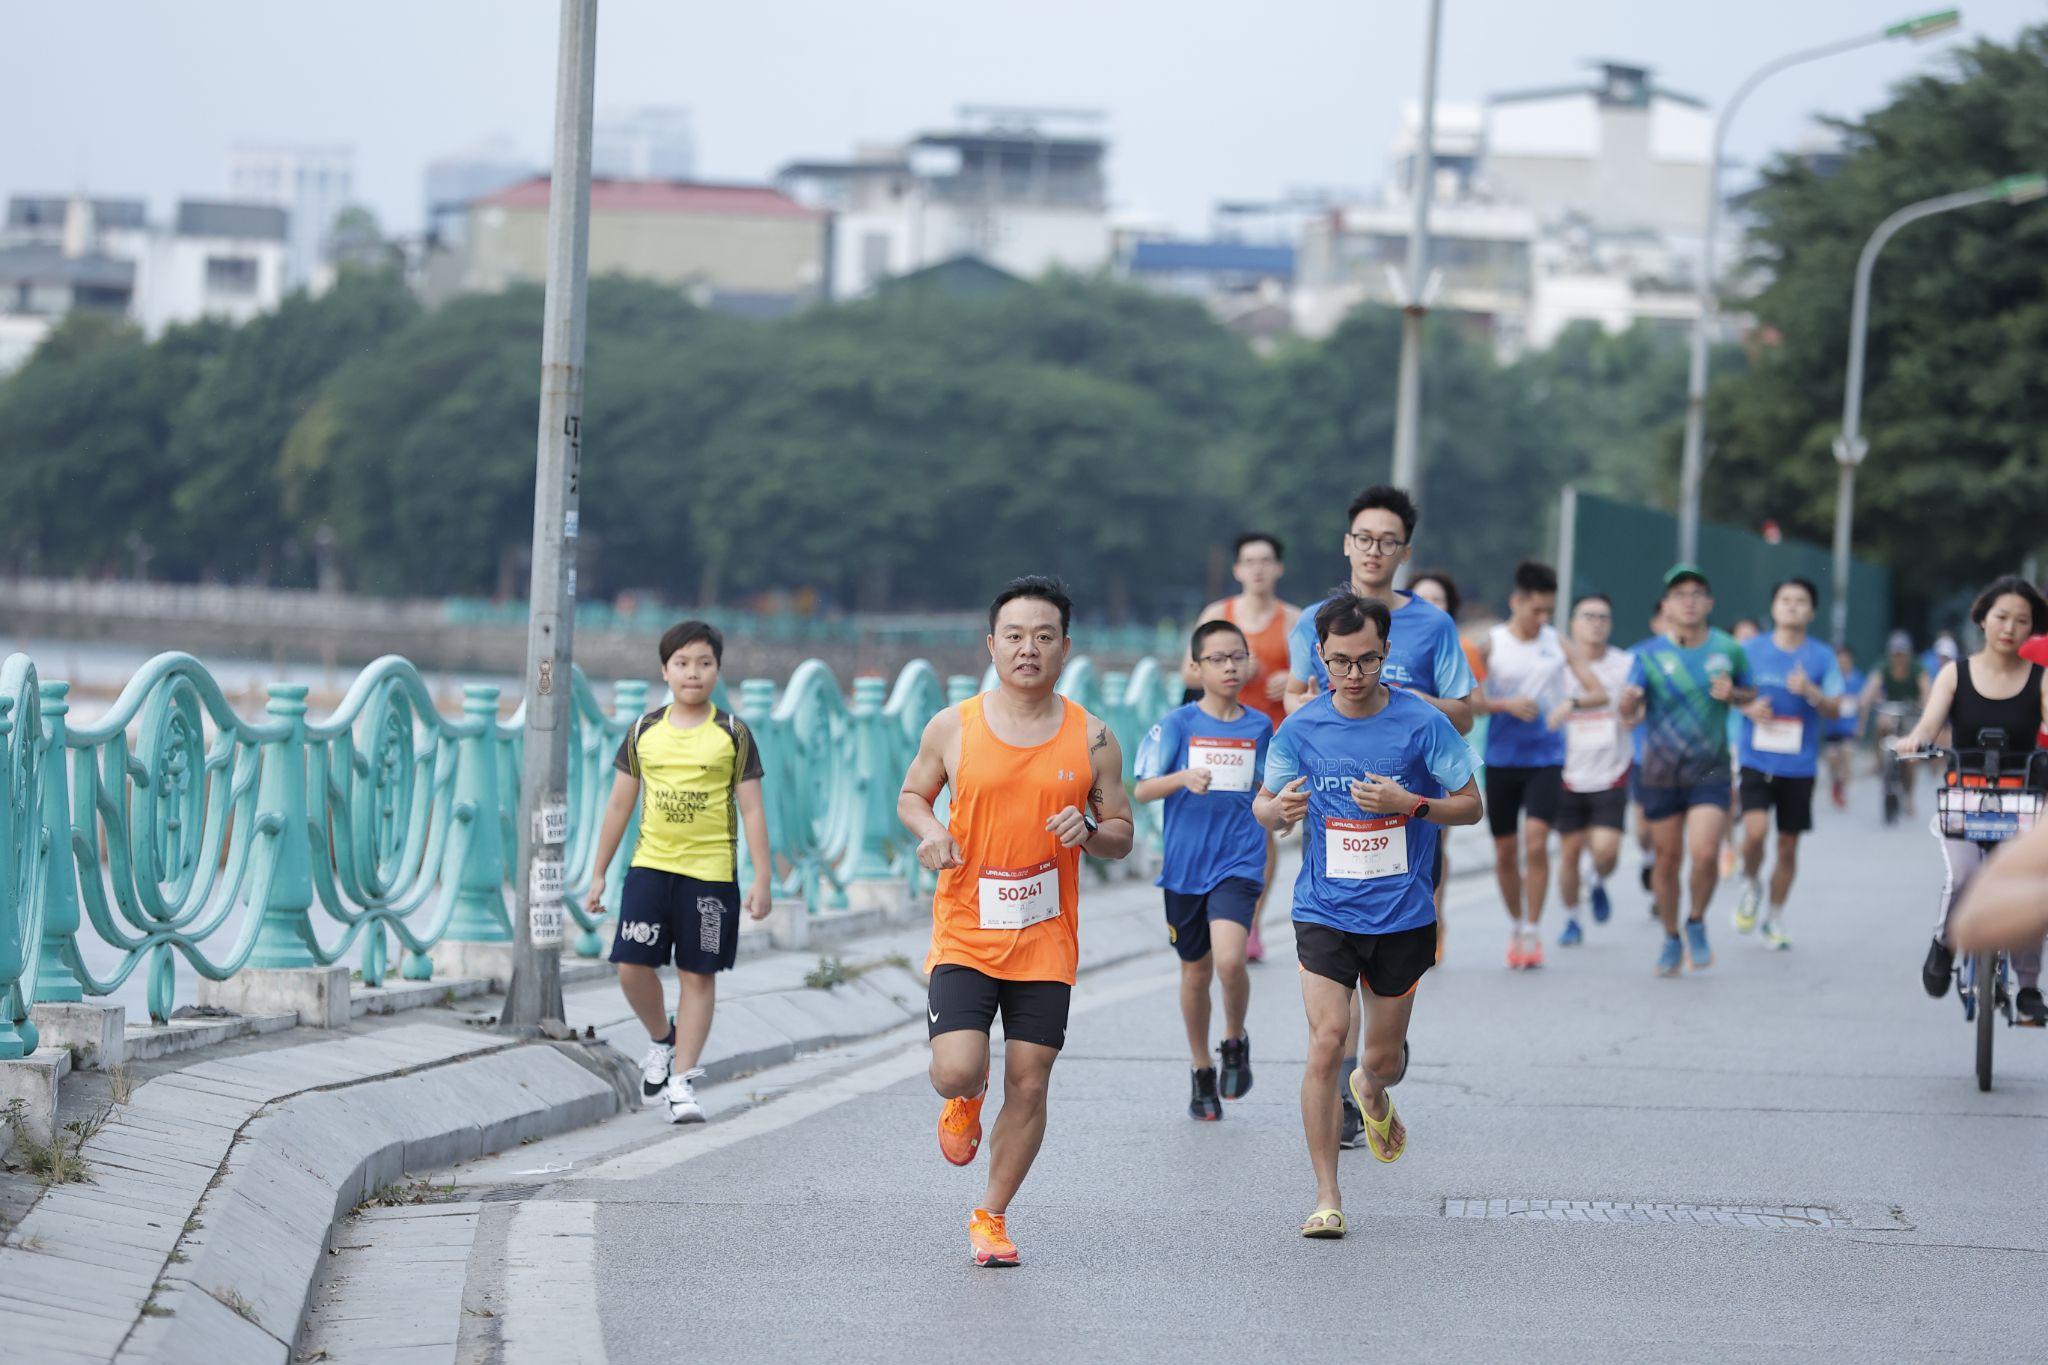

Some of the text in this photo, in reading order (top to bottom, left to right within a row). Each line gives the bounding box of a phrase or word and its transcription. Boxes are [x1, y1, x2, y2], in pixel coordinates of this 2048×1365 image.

[1205, 753, 1244, 766] 50226
[665, 812, 695, 824] 2023
[1343, 837, 1389, 852] 50239
[998, 881, 1042, 901] 50241
